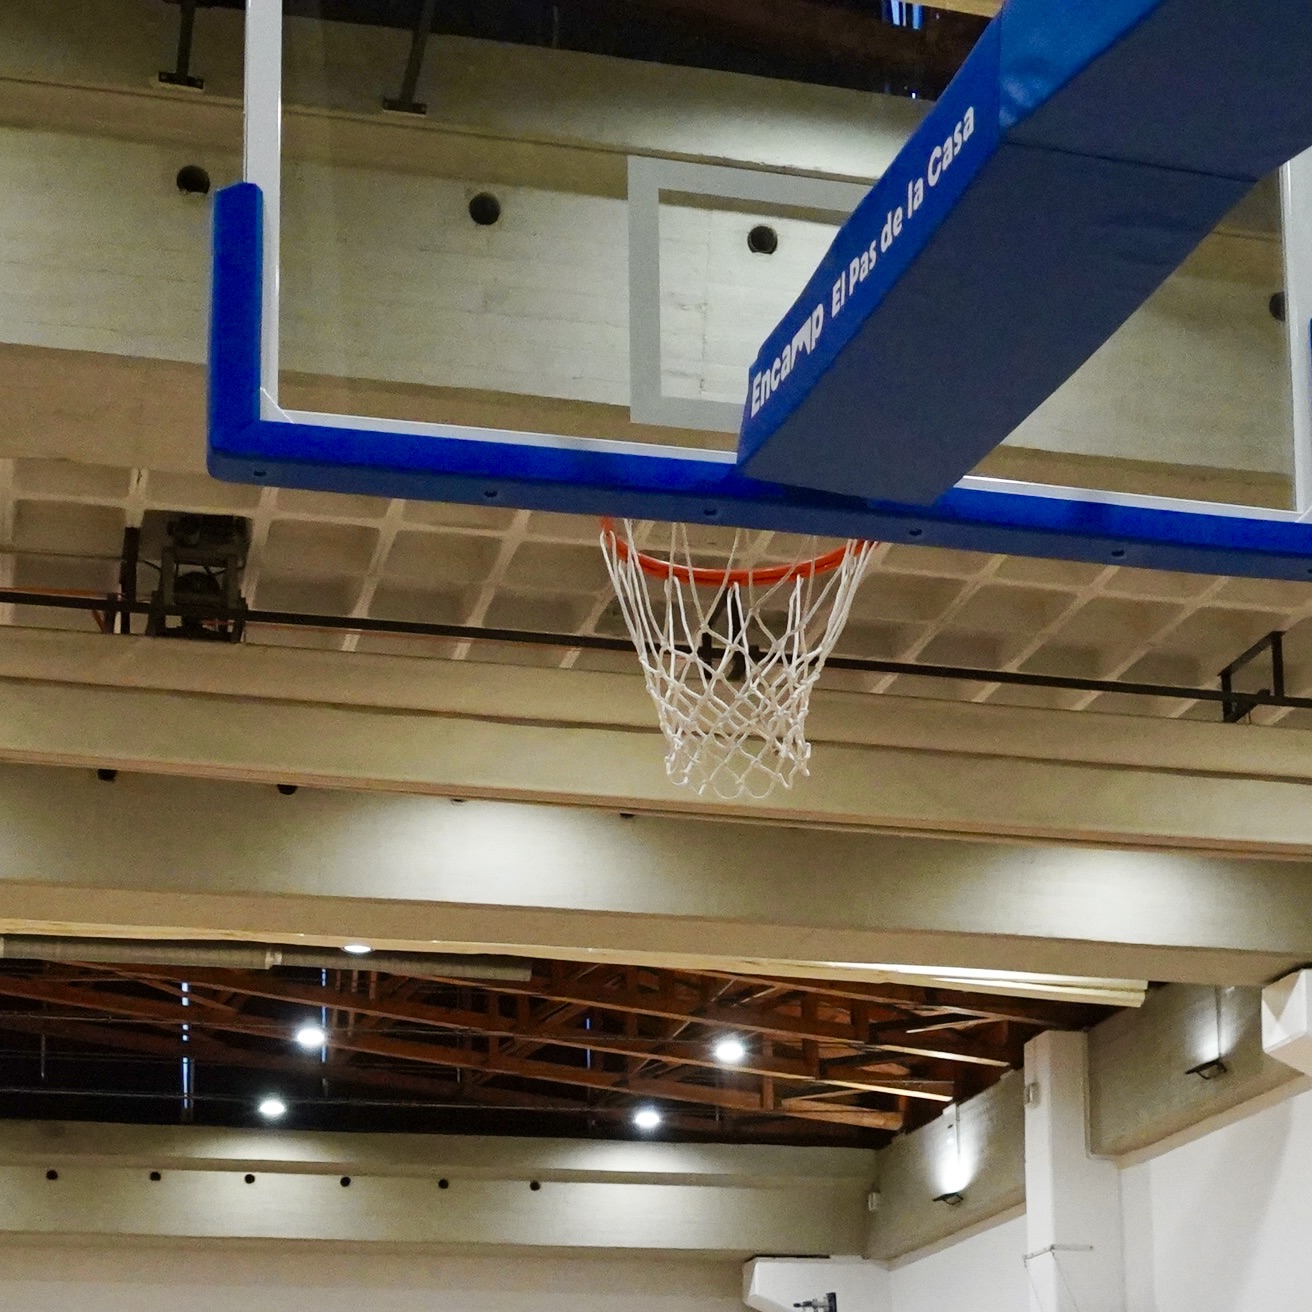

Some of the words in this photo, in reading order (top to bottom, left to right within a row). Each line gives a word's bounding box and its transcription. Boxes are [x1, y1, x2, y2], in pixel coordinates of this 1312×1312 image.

[750, 303, 824, 419] Encamp
[831, 271, 846, 318] El
[848, 239, 877, 296] Pas
[880, 205, 903, 253] de
[906, 176, 924, 219] la
[927, 106, 975, 188] Casa
